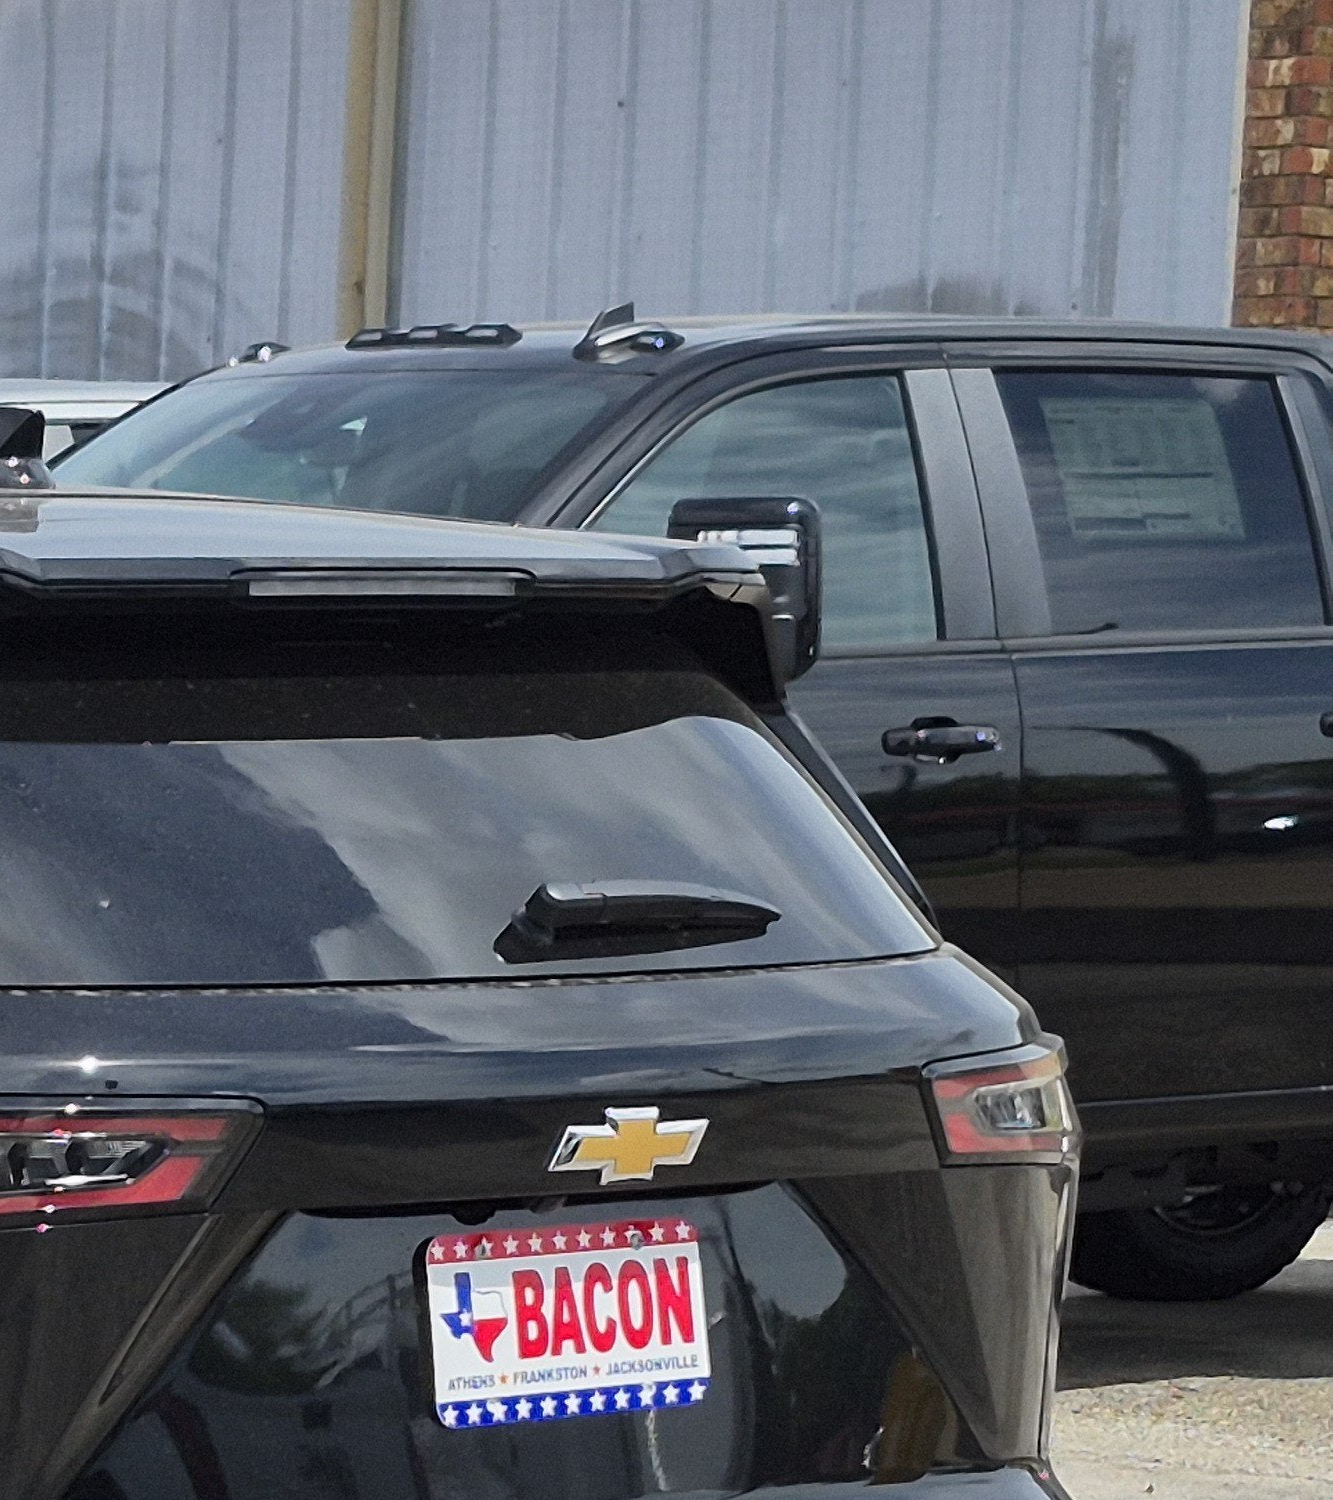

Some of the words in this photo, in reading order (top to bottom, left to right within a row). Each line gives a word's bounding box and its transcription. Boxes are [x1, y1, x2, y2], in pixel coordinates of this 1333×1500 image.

[512, 1256, 694, 1359] BACON
[448, 1374, 495, 1391] ATHENS
[513, 1364, 587, 1386] FRANKSTON
[605, 1354, 698, 1377] JACKSONVILLE
